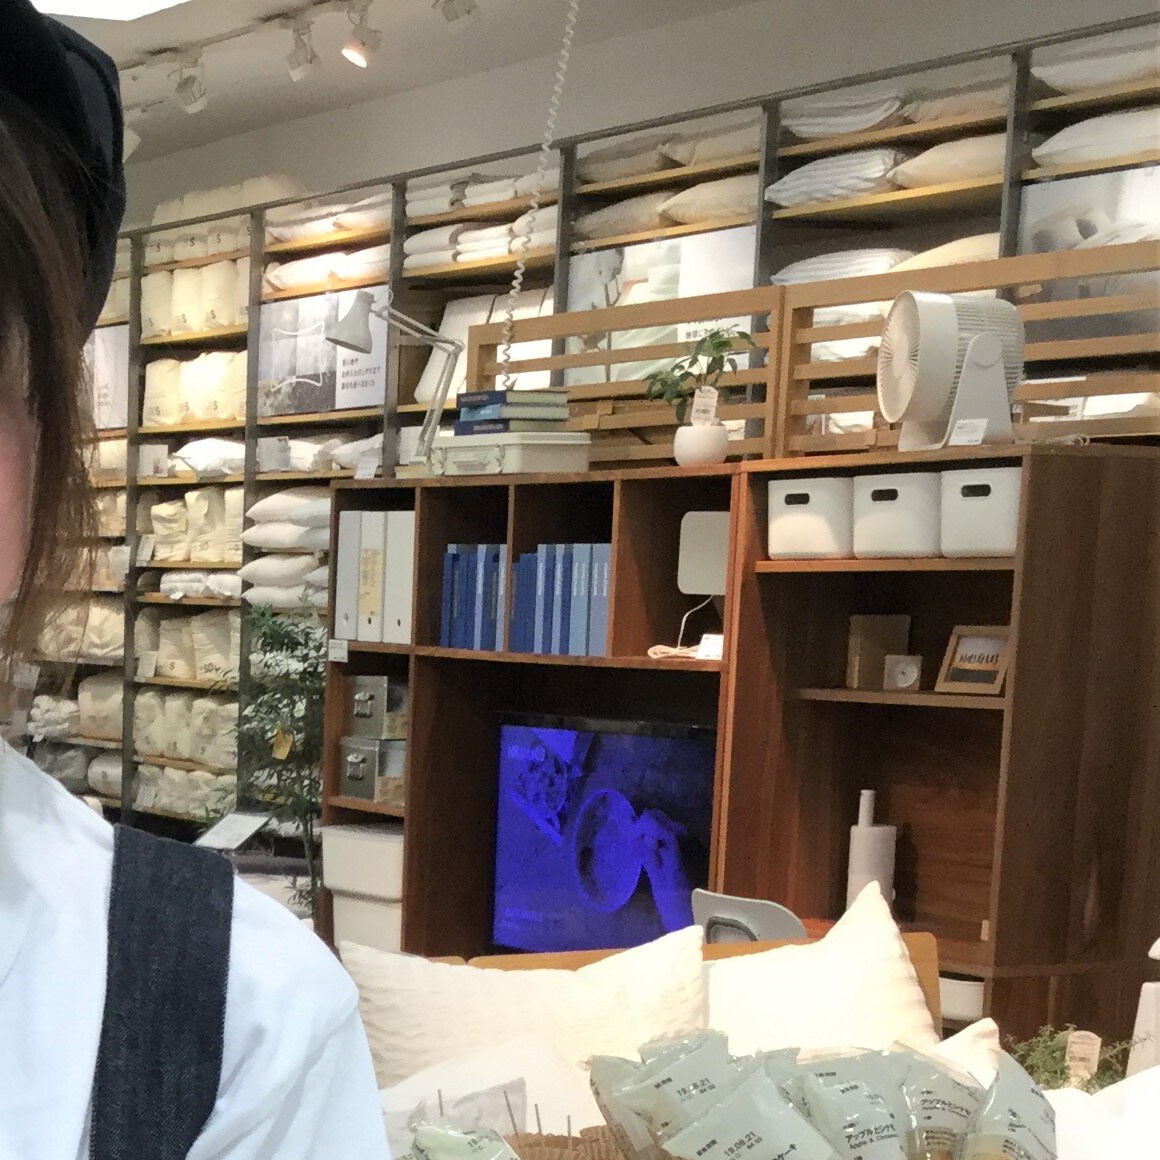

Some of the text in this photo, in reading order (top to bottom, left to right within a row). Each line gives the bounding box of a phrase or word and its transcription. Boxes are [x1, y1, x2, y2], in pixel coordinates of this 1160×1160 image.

[181, 314, 186, 323] S
[211, 310, 216, 319] S
[213, 401, 218, 410] S
[155, 406, 160, 416] S
[169, 662, 176, 670] S
